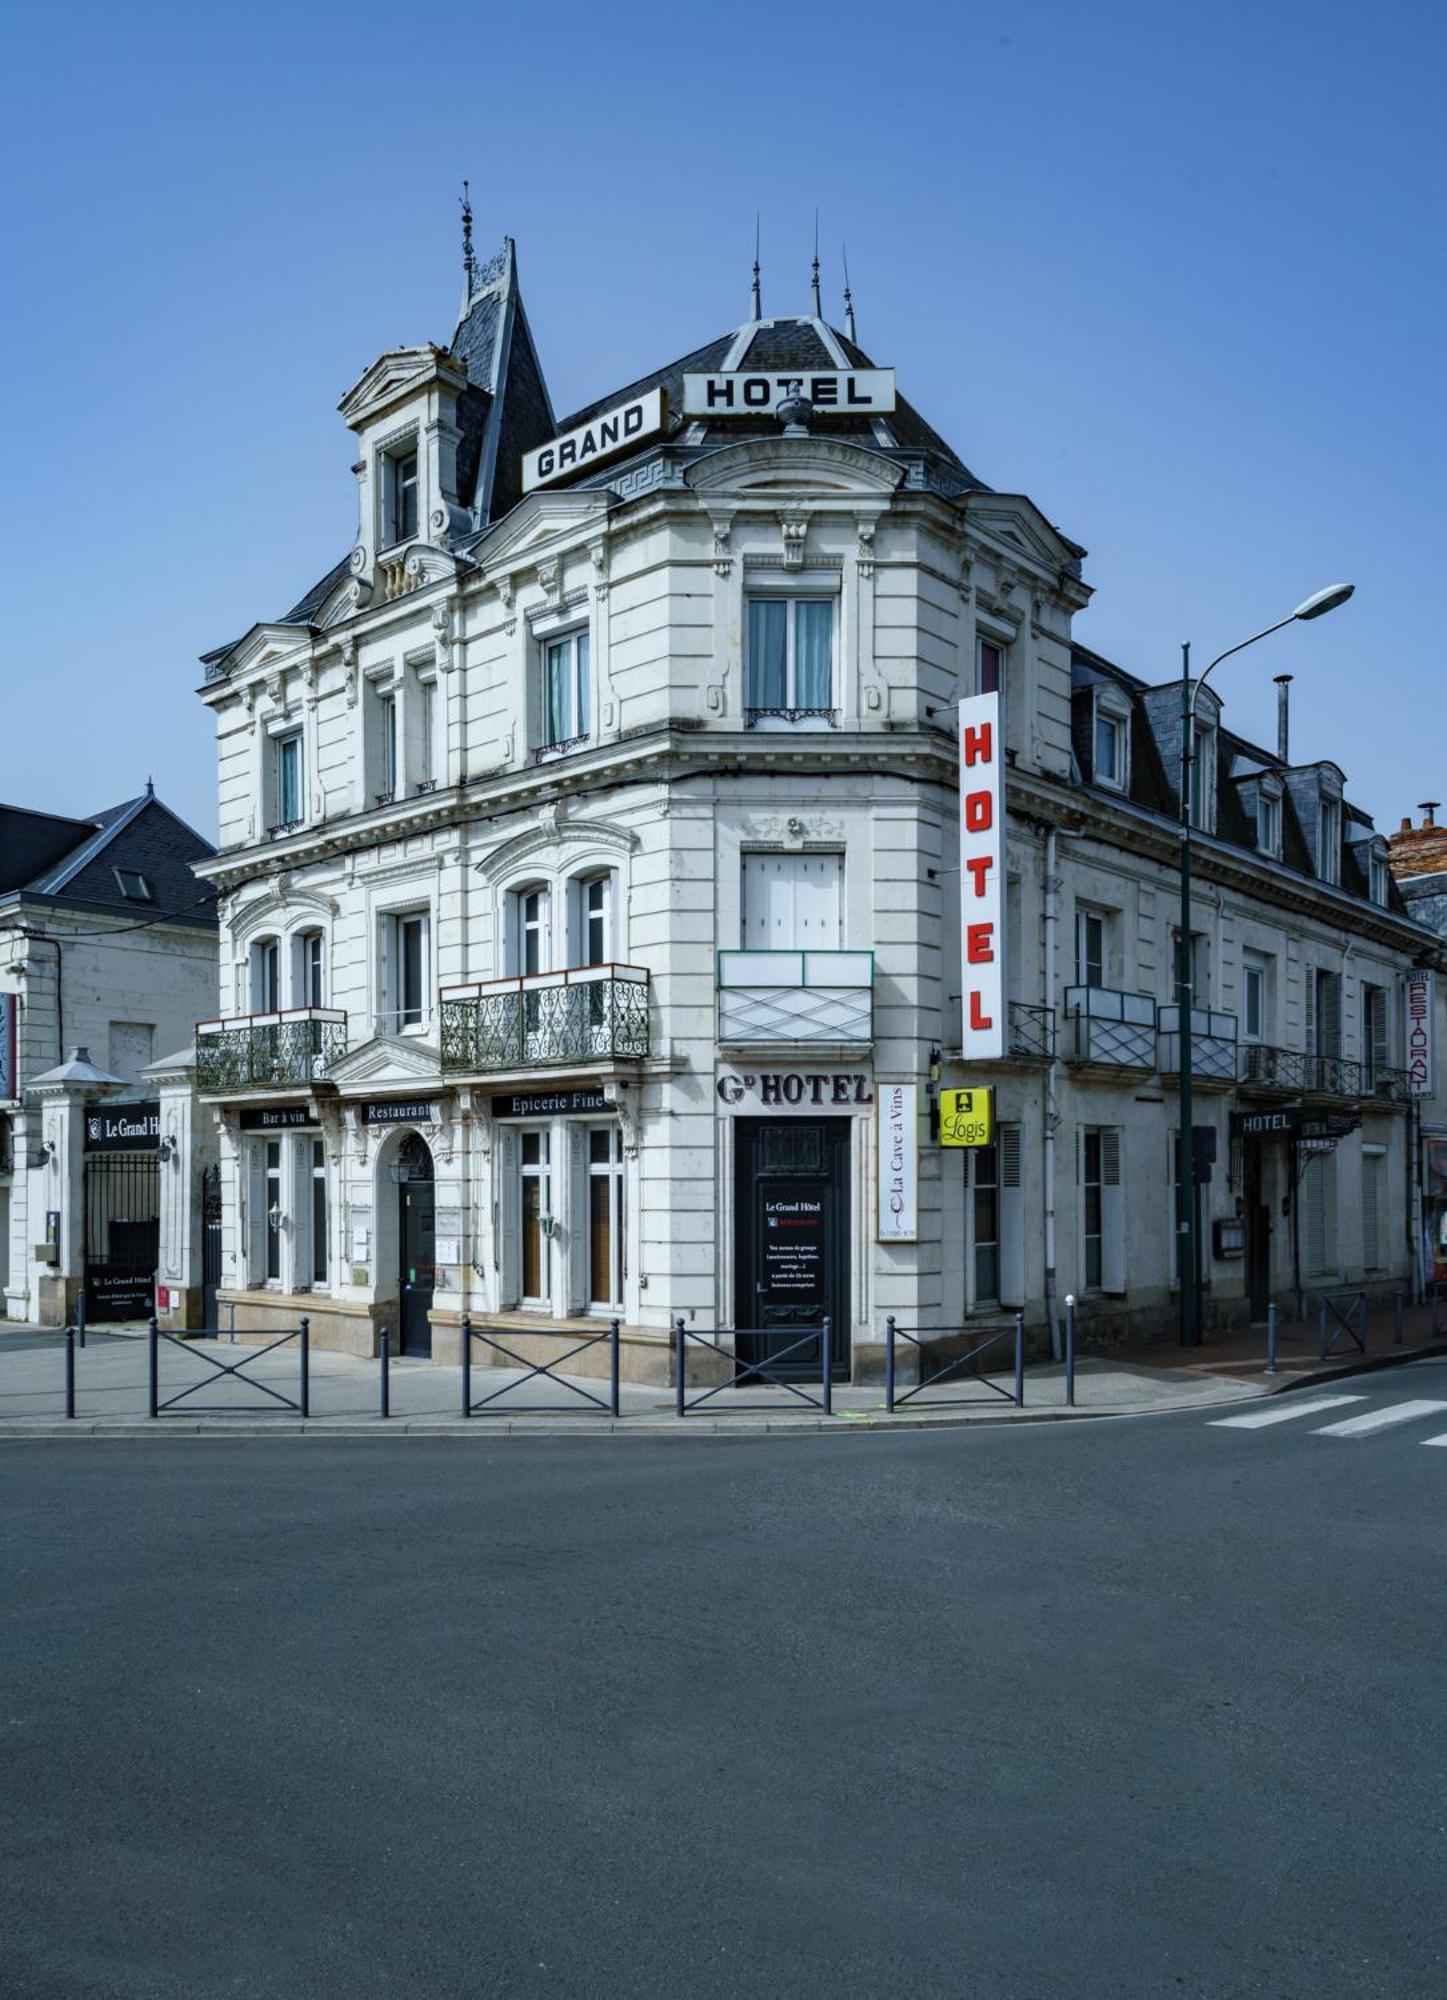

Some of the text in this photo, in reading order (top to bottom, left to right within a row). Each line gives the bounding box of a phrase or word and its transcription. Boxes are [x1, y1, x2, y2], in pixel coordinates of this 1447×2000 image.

[706, 377, 872, 407] HOTEL
[538, 404, 643, 478] GRAND
[965, 722, 994, 1030] HOTEL
[1410, 982, 1427, 1090] RESTAURANT
[512, 1092, 603, 1115] Epicerie Fine
[760, 1074, 874, 1105] HOTEL
[890, 1087, 903, 1120] Vins
[105, 1119, 117, 1137] Le
[118, 1116, 148, 1137] Grand
[263, 1109, 305, 1125] Bar à vin
[368, 1103, 430, 1120] Restaurant
[1243, 1114, 1291, 1132] HOTEL
[889, 1123, 903, 1131] à
[943, 1113, 986, 1143] Logis
[890, 1136, 903, 1172] Cave
[766, 1202, 776, 1211] Le
[776, 1202, 798, 1211] Grand
